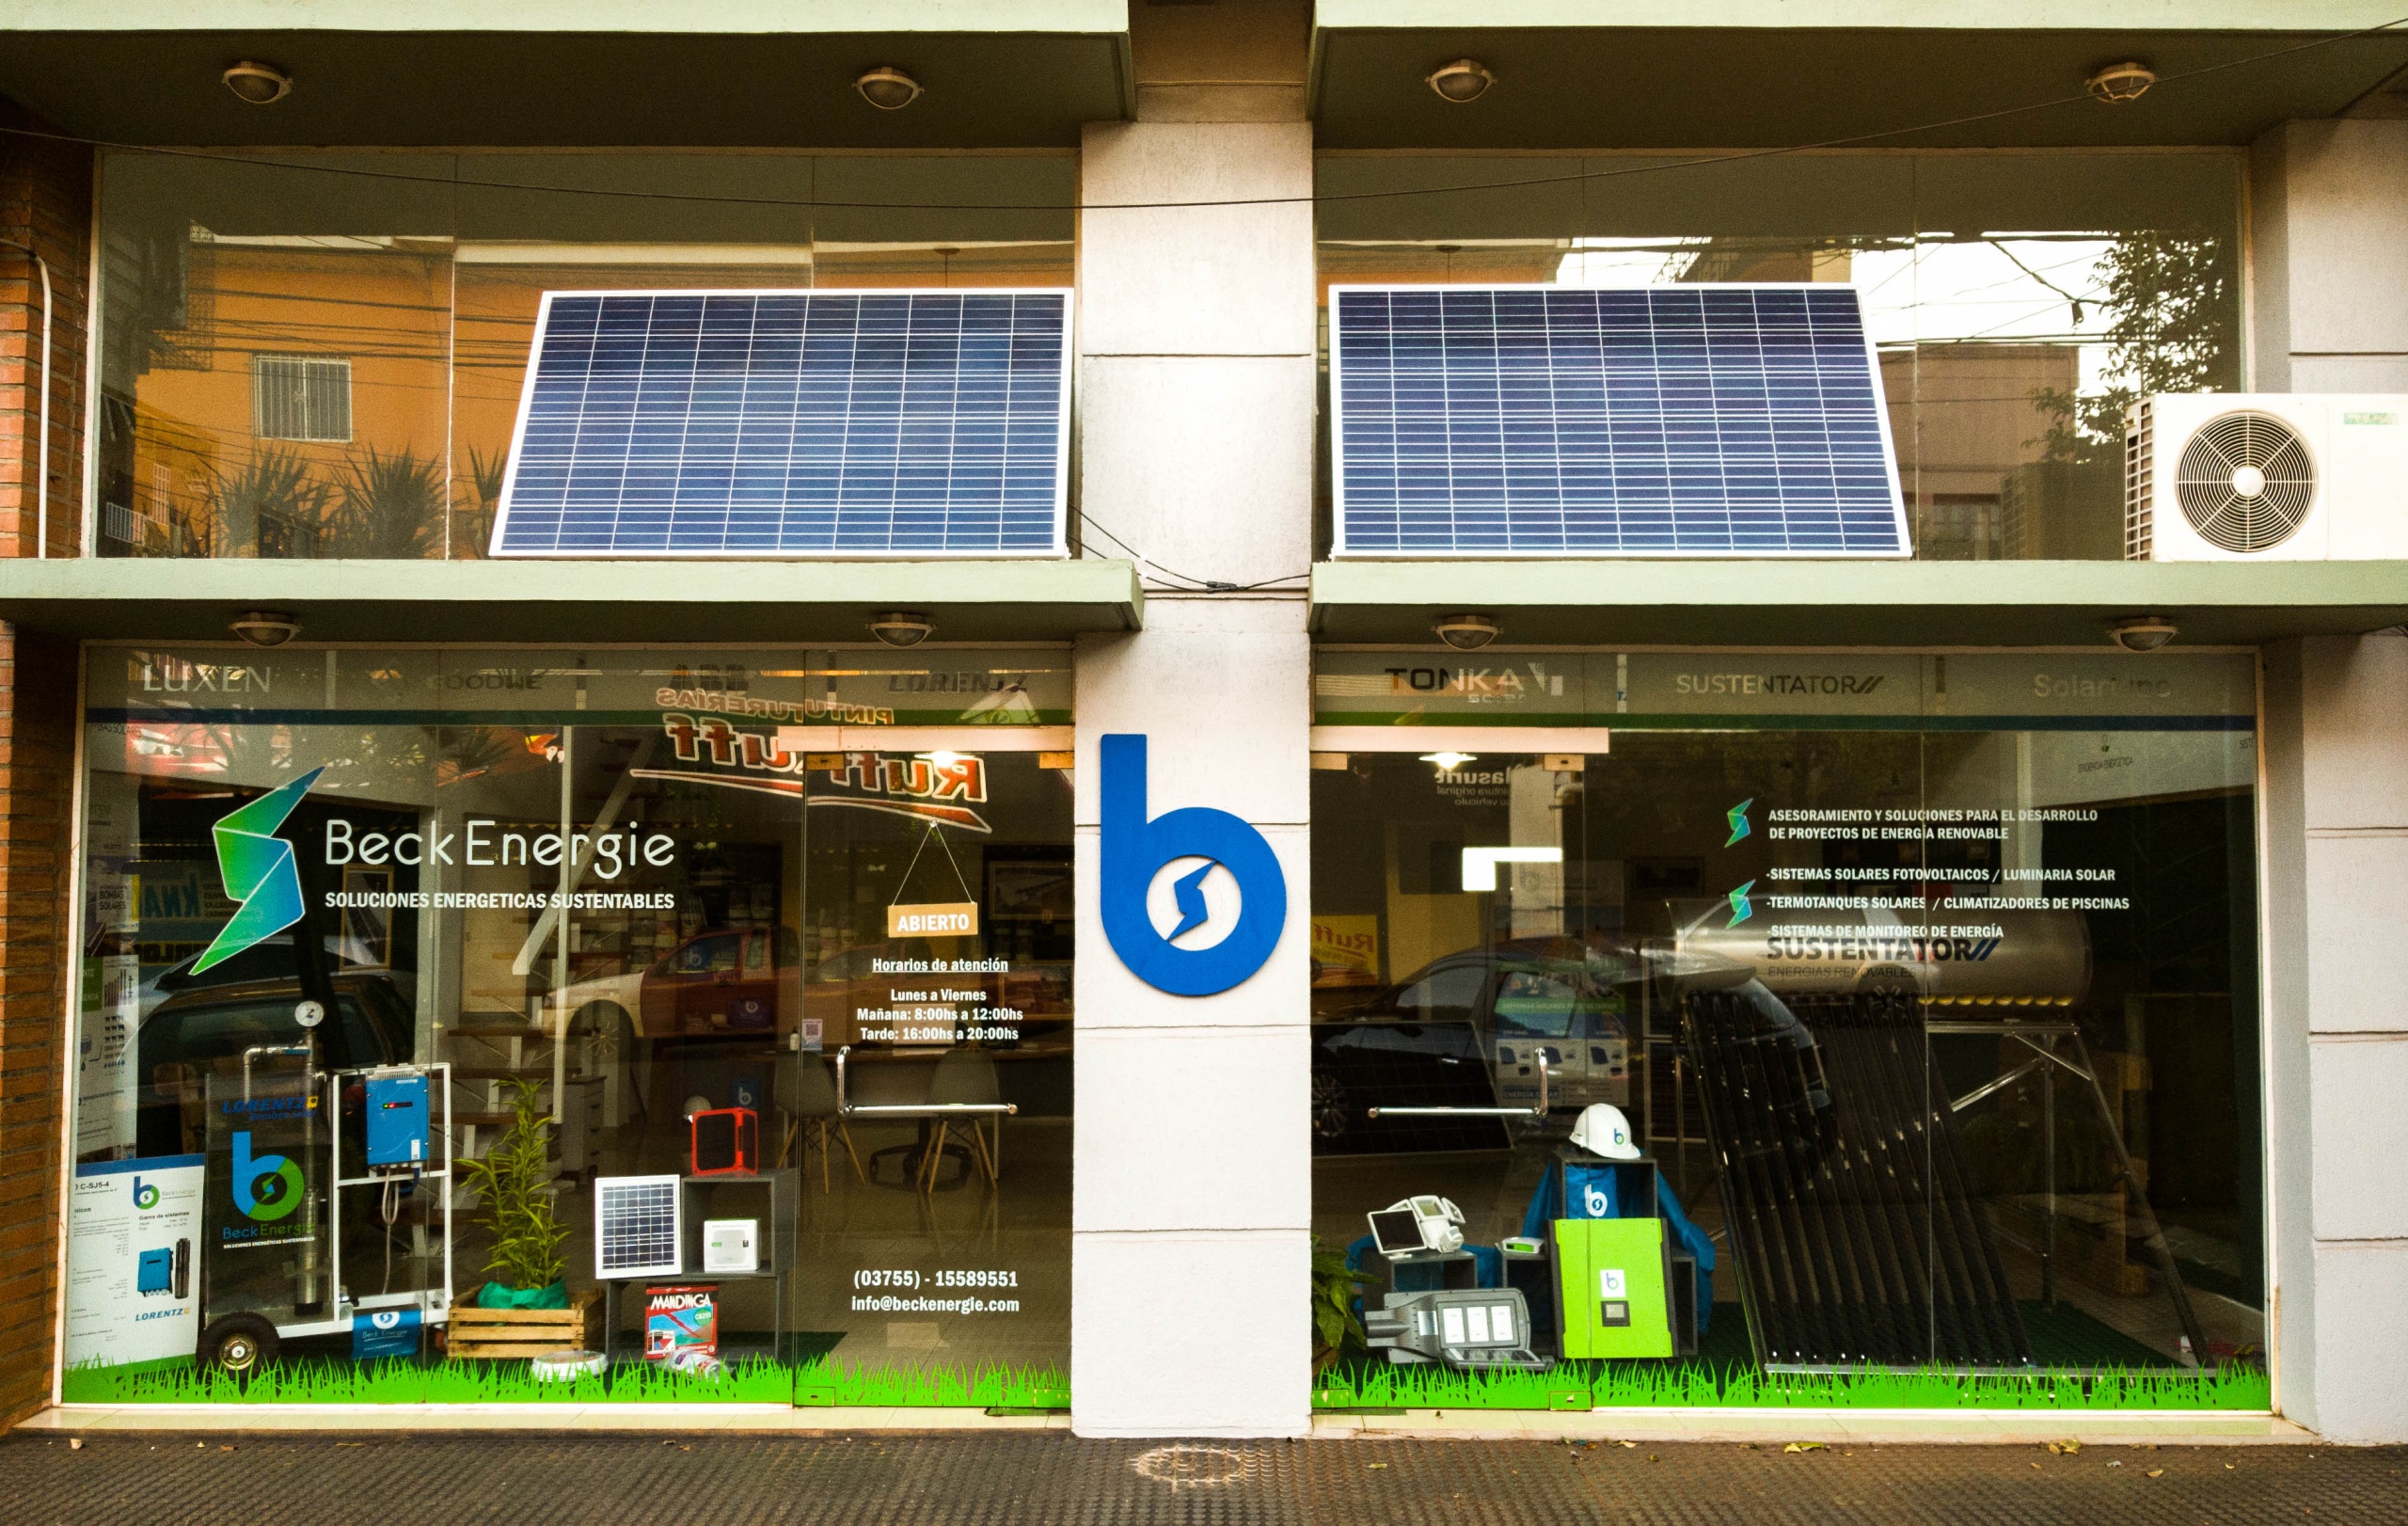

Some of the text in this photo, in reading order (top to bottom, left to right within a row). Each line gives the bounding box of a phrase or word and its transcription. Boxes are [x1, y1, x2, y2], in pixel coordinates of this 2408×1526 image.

[143, 664, 271, 692] LUXEN
[1385, 667, 1524, 691] TONKA
[1768, 809, 2098, 821] ASESORAMIENTO Y SOLUCIONES PARA EL DESARROLLO
[1769, 828, 1785, 839] DE
[1788, 827, 1859, 839] PROYECTOS
[1861, 827, 1878, 839] DE
[1938, 827, 2009, 839] RENOVABLE
[325, 819, 675, 880] Beck Energie
[1834, 868, 1890, 881] SOLARES
[1893, 868, 1989, 881] FOTOVOLTAICOS
[2004, 868, 2073, 881] LUMINARIA
[2076, 869, 2115, 881] SOLAR
[325, 892, 674, 909] SOLUCIONES ENERGETICAS SUSTENTABLES
[1871, 897, 1925, 909] SOLARES
[1943, 897, 2050, 910] CLIMATIZADORES
[2052, 898, 2069, 909] DE
[2071, 898, 2130, 910] PISCINAS
[897, 914, 970, 931] ABIERTO
[1836, 926, 1853, 937] DE
[1855, 926, 1927, 938] MONITOREO
[1931, 926, 1948, 938] DE
[1950, 923, 2004, 938] ENERGÍA
[872, 957, 1009, 972] Horarios de atención
[1768, 966, 1916, 979] ENERGIAS RENOVABLES
[891, 989, 987, 1001] Lunes a Viernes
[857, 1008, 1023, 1021] Mañana: 8:00hs a 12:00hs
[861, 1026, 1019, 1040] Tarde: 16:00hs a 20:00hs
[221, 1096, 307, 1114] LORENTZ
[222, 1222, 316, 1240] Beck Energie
[854, 1270, 922, 1289] (03755)
[935, 1270, 1019, 1287] 15589551
[650, 1293, 712, 1311] MANDINGA
[851, 1295, 1020, 1315] info@beckenergie.com
[135, 1308, 183, 1322] LORENTZ
